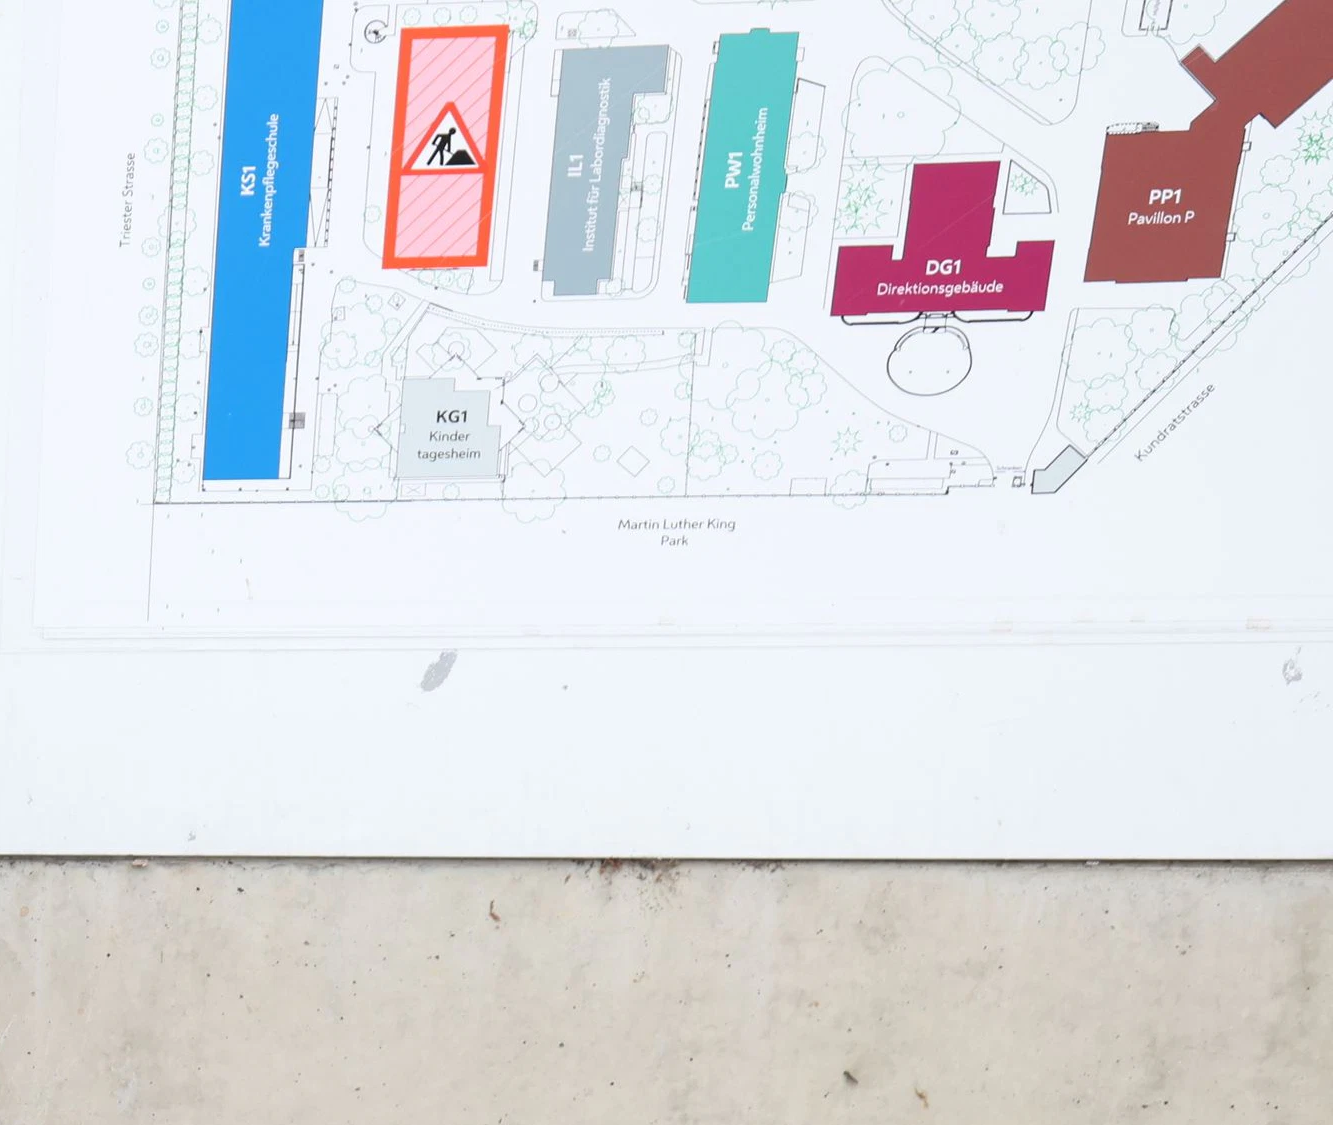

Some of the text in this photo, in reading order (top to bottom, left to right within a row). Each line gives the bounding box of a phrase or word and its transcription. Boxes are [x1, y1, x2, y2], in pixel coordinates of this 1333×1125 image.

[567, 154, 584, 177] IL1
[582, 77, 612, 252] Institut für Labordiagnostik
[724, 151, 743, 189] PW1
[741, 107, 768, 231] Personalwohnheim
[240, 165, 256, 196] KS1
[258, 113, 280, 247] Krankenpflegeschule
[119, 153, 136, 247] Triester Strasse
[1148, 188, 1182, 205] PP1
[1127, 210, 1195, 225] Pavillon P
[925, 259, 962, 276] DG1
[876, 280, 1004, 298] Direktionsgebäude
[436, 410, 468, 423] KG1
[1134, 384, 1215, 462] Kundratstrasse
[429, 430, 470, 442] Kinder
[417, 447, 481, 462] tagesheim
[617, 518, 736, 532] Martin Luther King
[660, 534, 689, 546] Park
